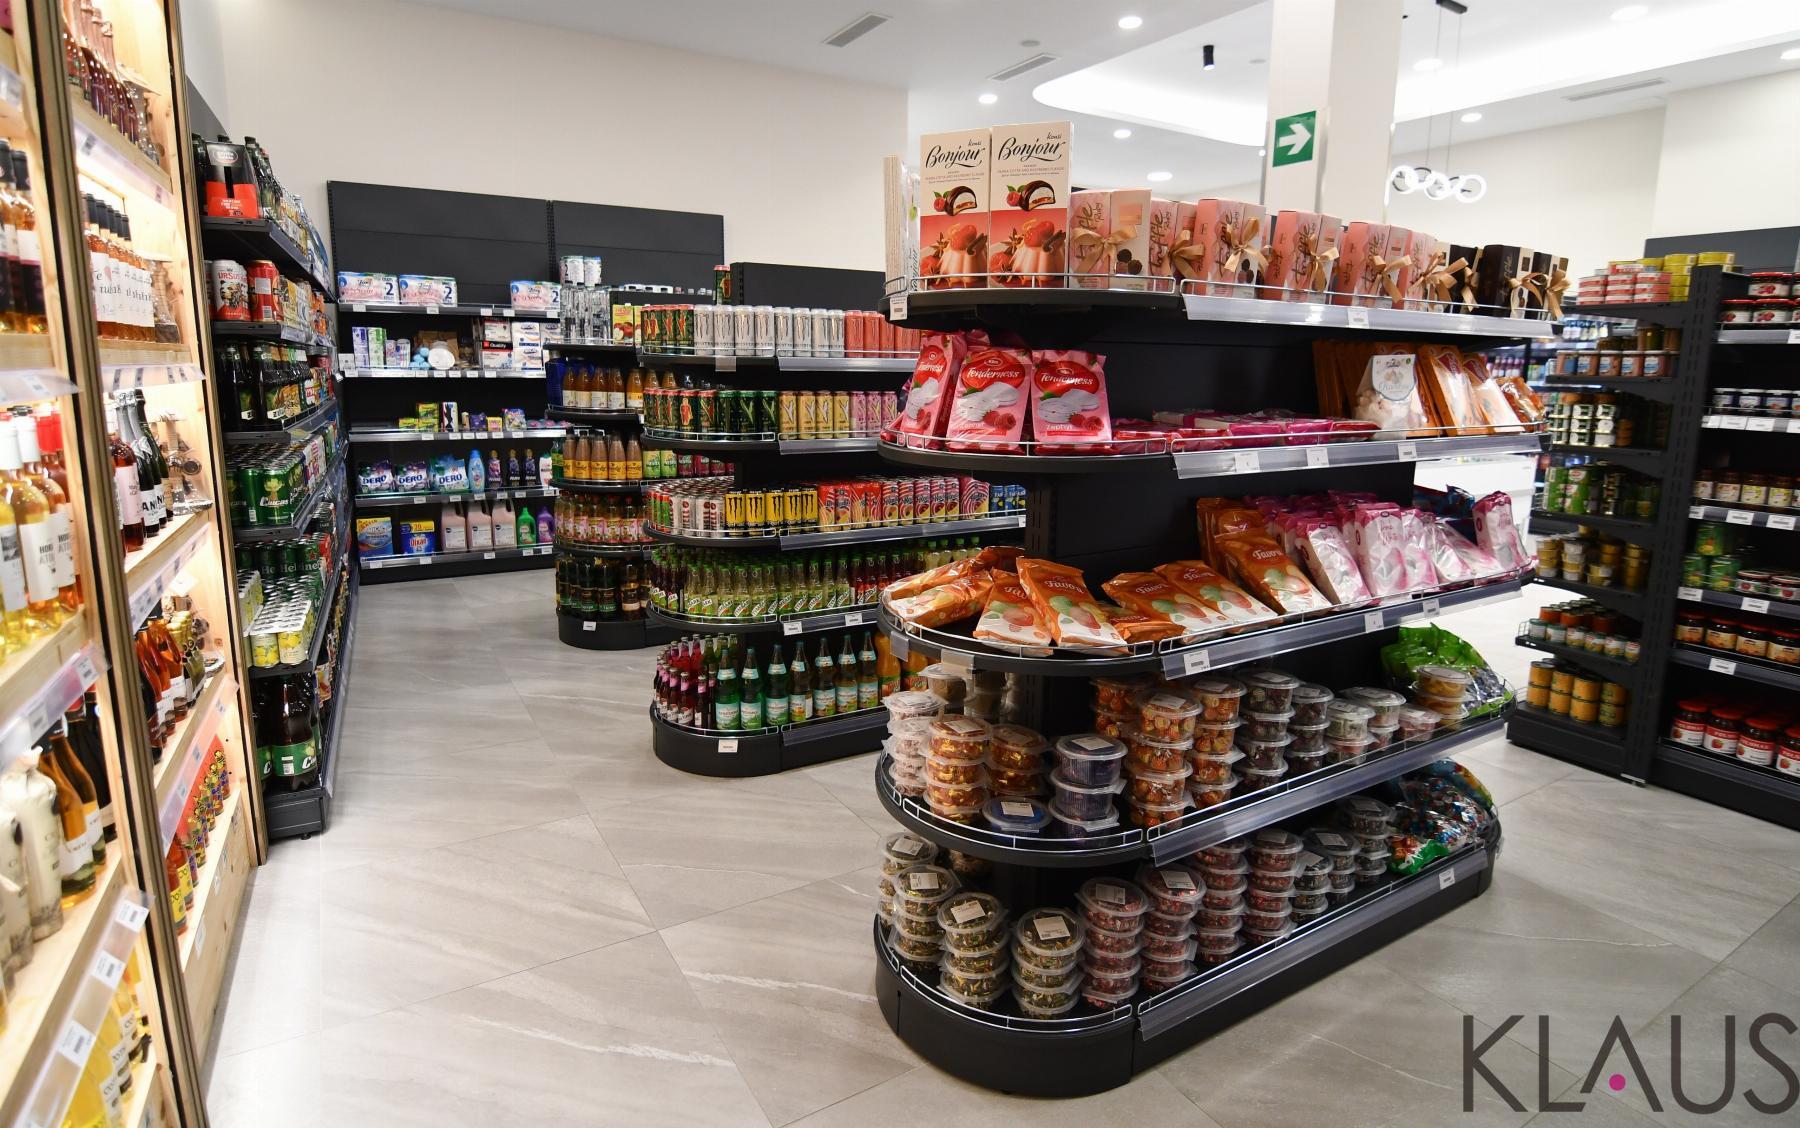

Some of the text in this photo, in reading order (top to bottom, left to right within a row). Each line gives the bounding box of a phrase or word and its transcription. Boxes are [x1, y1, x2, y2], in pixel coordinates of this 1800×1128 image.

[998, 137, 1067, 162] Bonjour
[925, 145, 986, 169] Bonjour
[966, 367, 1020, 378] Tenderness
[362, 474, 387, 485] DERO
[399, 474, 423, 484] DERO
[439, 473, 463, 485] DERO
